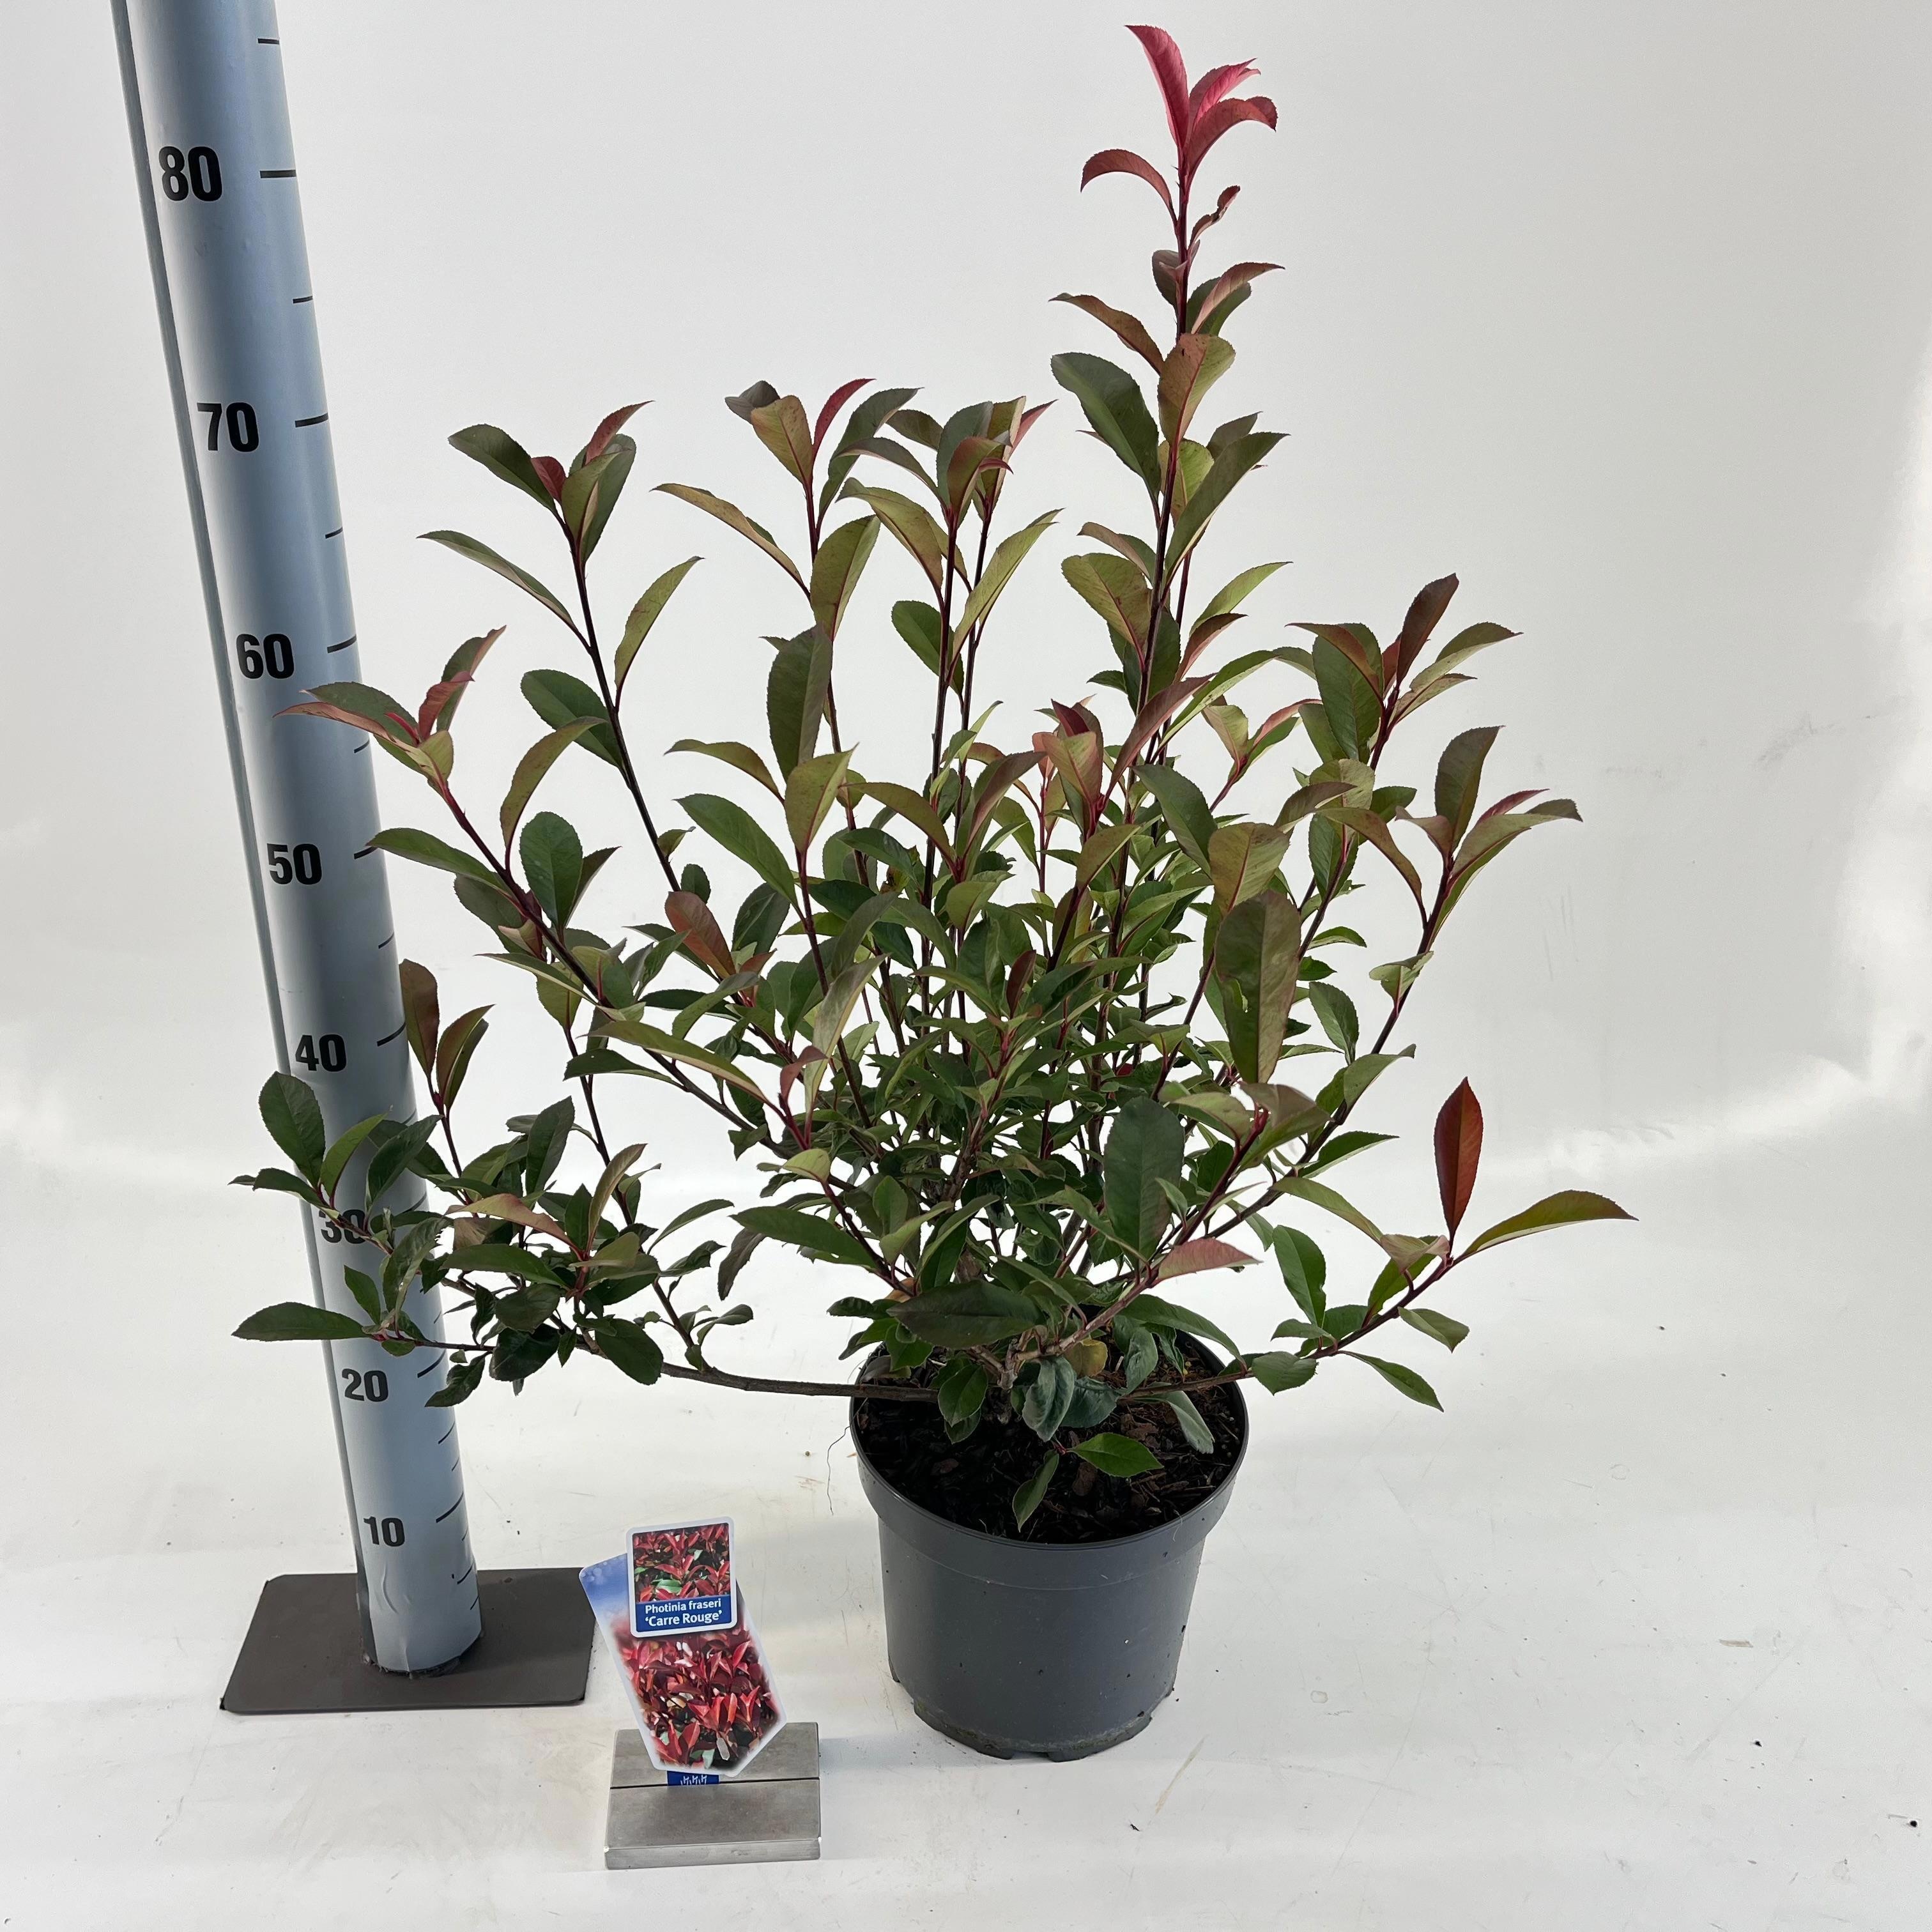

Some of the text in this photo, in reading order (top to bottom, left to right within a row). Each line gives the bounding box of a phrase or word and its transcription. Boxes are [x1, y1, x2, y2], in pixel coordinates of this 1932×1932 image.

[160, 146, 222, 202] 80
[197, 402, 259, 453] 70
[237, 633, 294, 679] 60
[267, 843, 323, 885] 50
[296, 1034, 347, 1072] 40
[342, 1368, 389, 1402] 20
[364, 1516, 405, 1547] 10
[645, 1598, 721, 1614] Photinia fraseri
